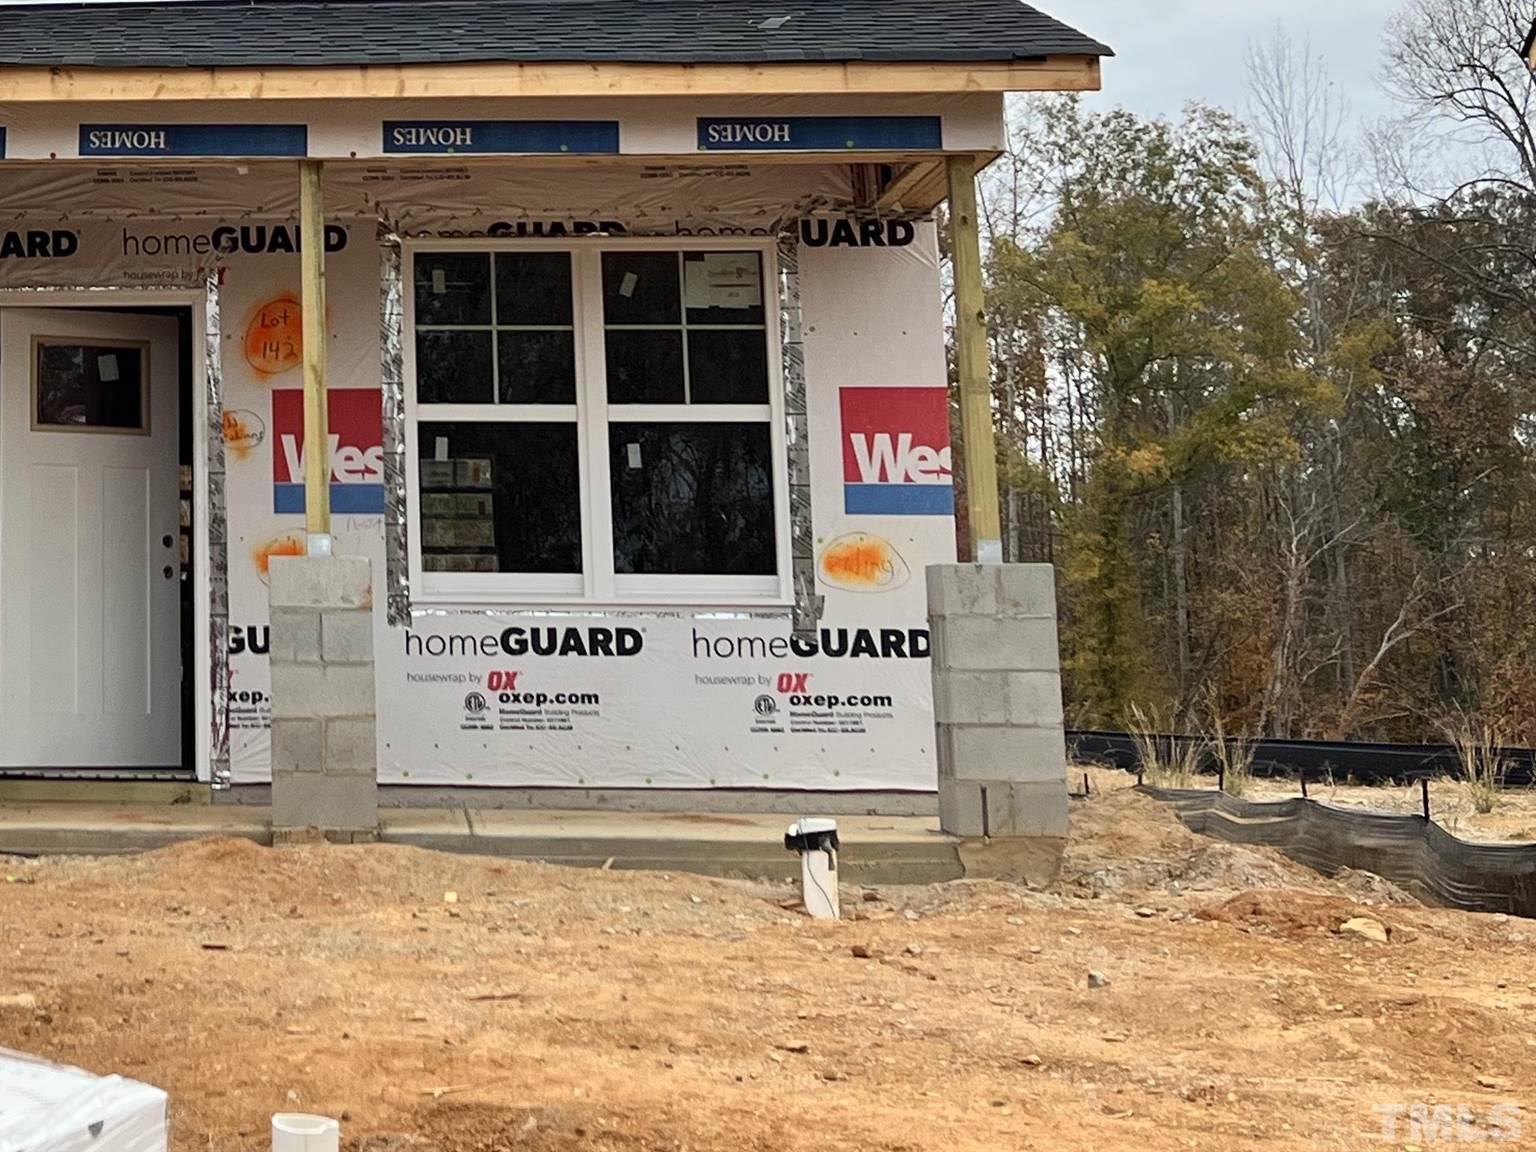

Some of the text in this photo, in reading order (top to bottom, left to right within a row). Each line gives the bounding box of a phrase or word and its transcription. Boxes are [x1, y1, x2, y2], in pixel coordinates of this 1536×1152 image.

[123, 224, 349, 257] homeGUAD
[261, 309, 289, 329] Lot
[261, 340, 295, 361] 142
[281, 434, 384, 484] Wes
[850, 433, 952, 484] Wes
[405, 626, 644, 657] homeGUARD
[406, 671, 519, 691] housewrap by OX
[694, 673, 810, 693] housewrap by OX
[498, 691, 600, 706] oxep.com
[789, 694, 893, 709] oxep.com
